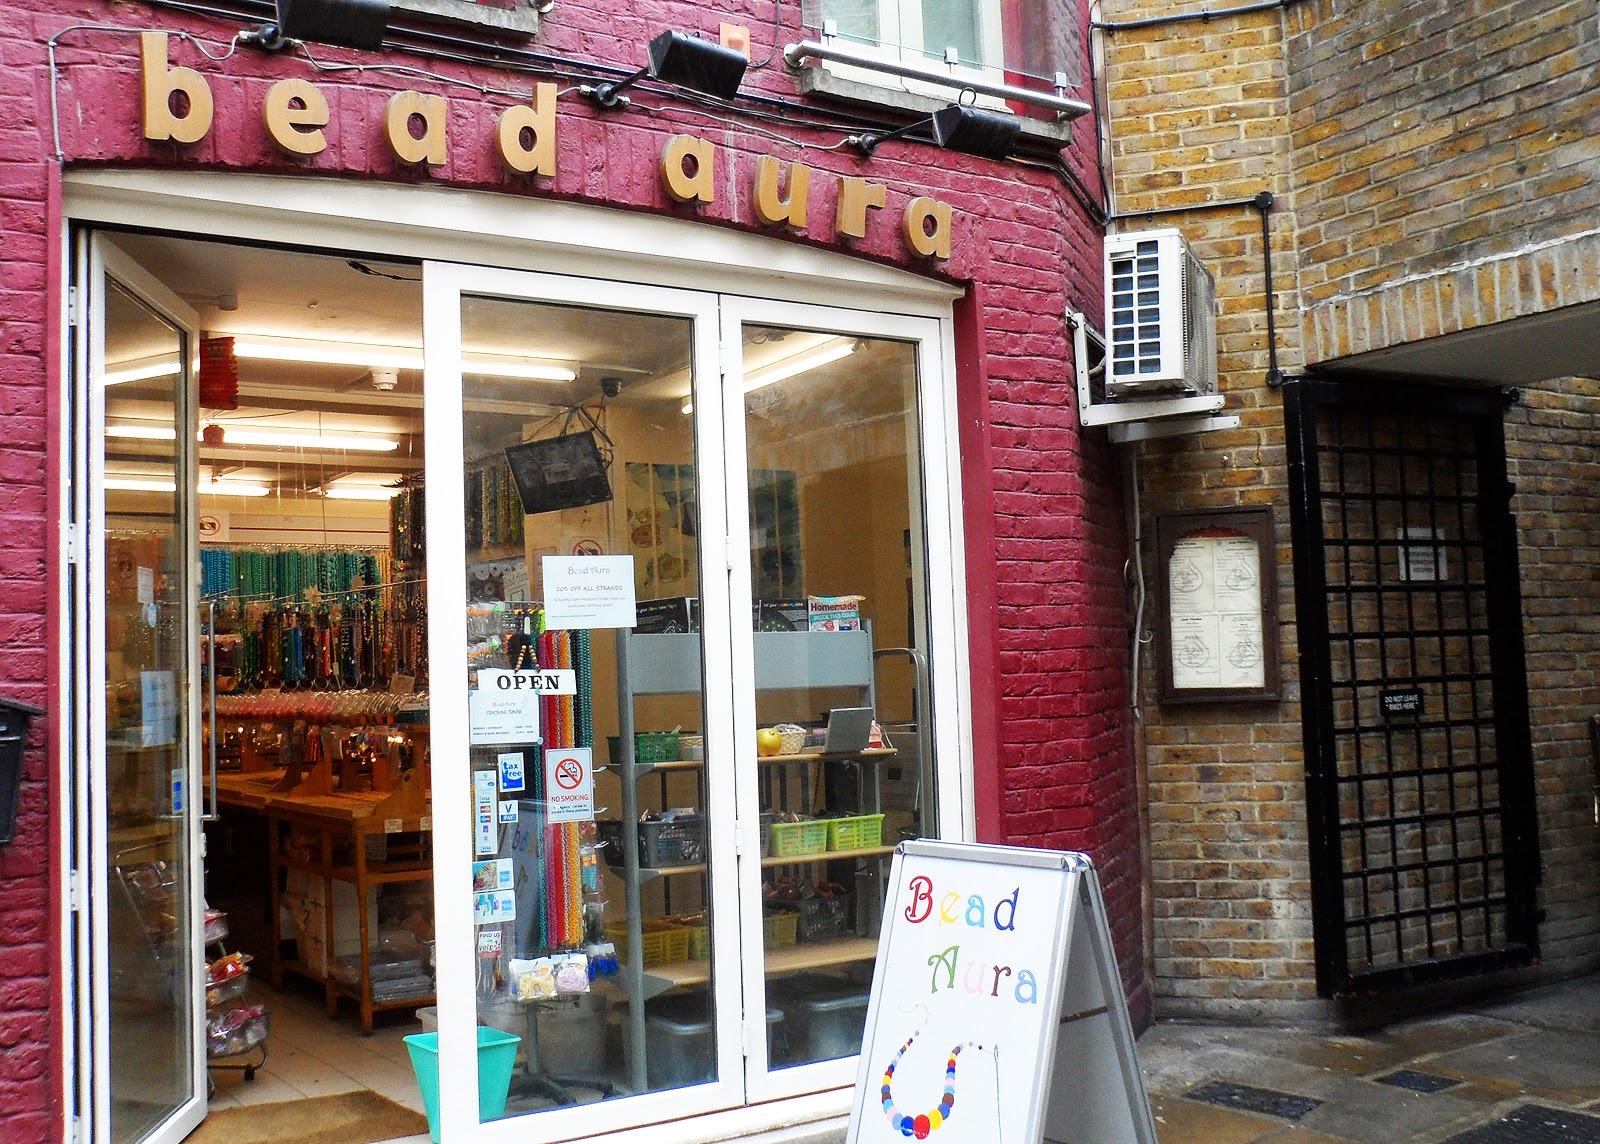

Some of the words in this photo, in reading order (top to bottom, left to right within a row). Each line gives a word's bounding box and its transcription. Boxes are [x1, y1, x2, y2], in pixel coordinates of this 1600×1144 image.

[141, 32, 558, 177] bead
[660, 133, 953, 260] aura
[810, 602, 857, 612] Homemade
[496, 675, 560, 690] OPEN
[503, 761, 519, 770] tax
[504, 770, 522, 780] free
[503, 803, 513, 813] V
[905, 875, 1020, 931] Bead
[927, 945, 1037, 1004] Aura
